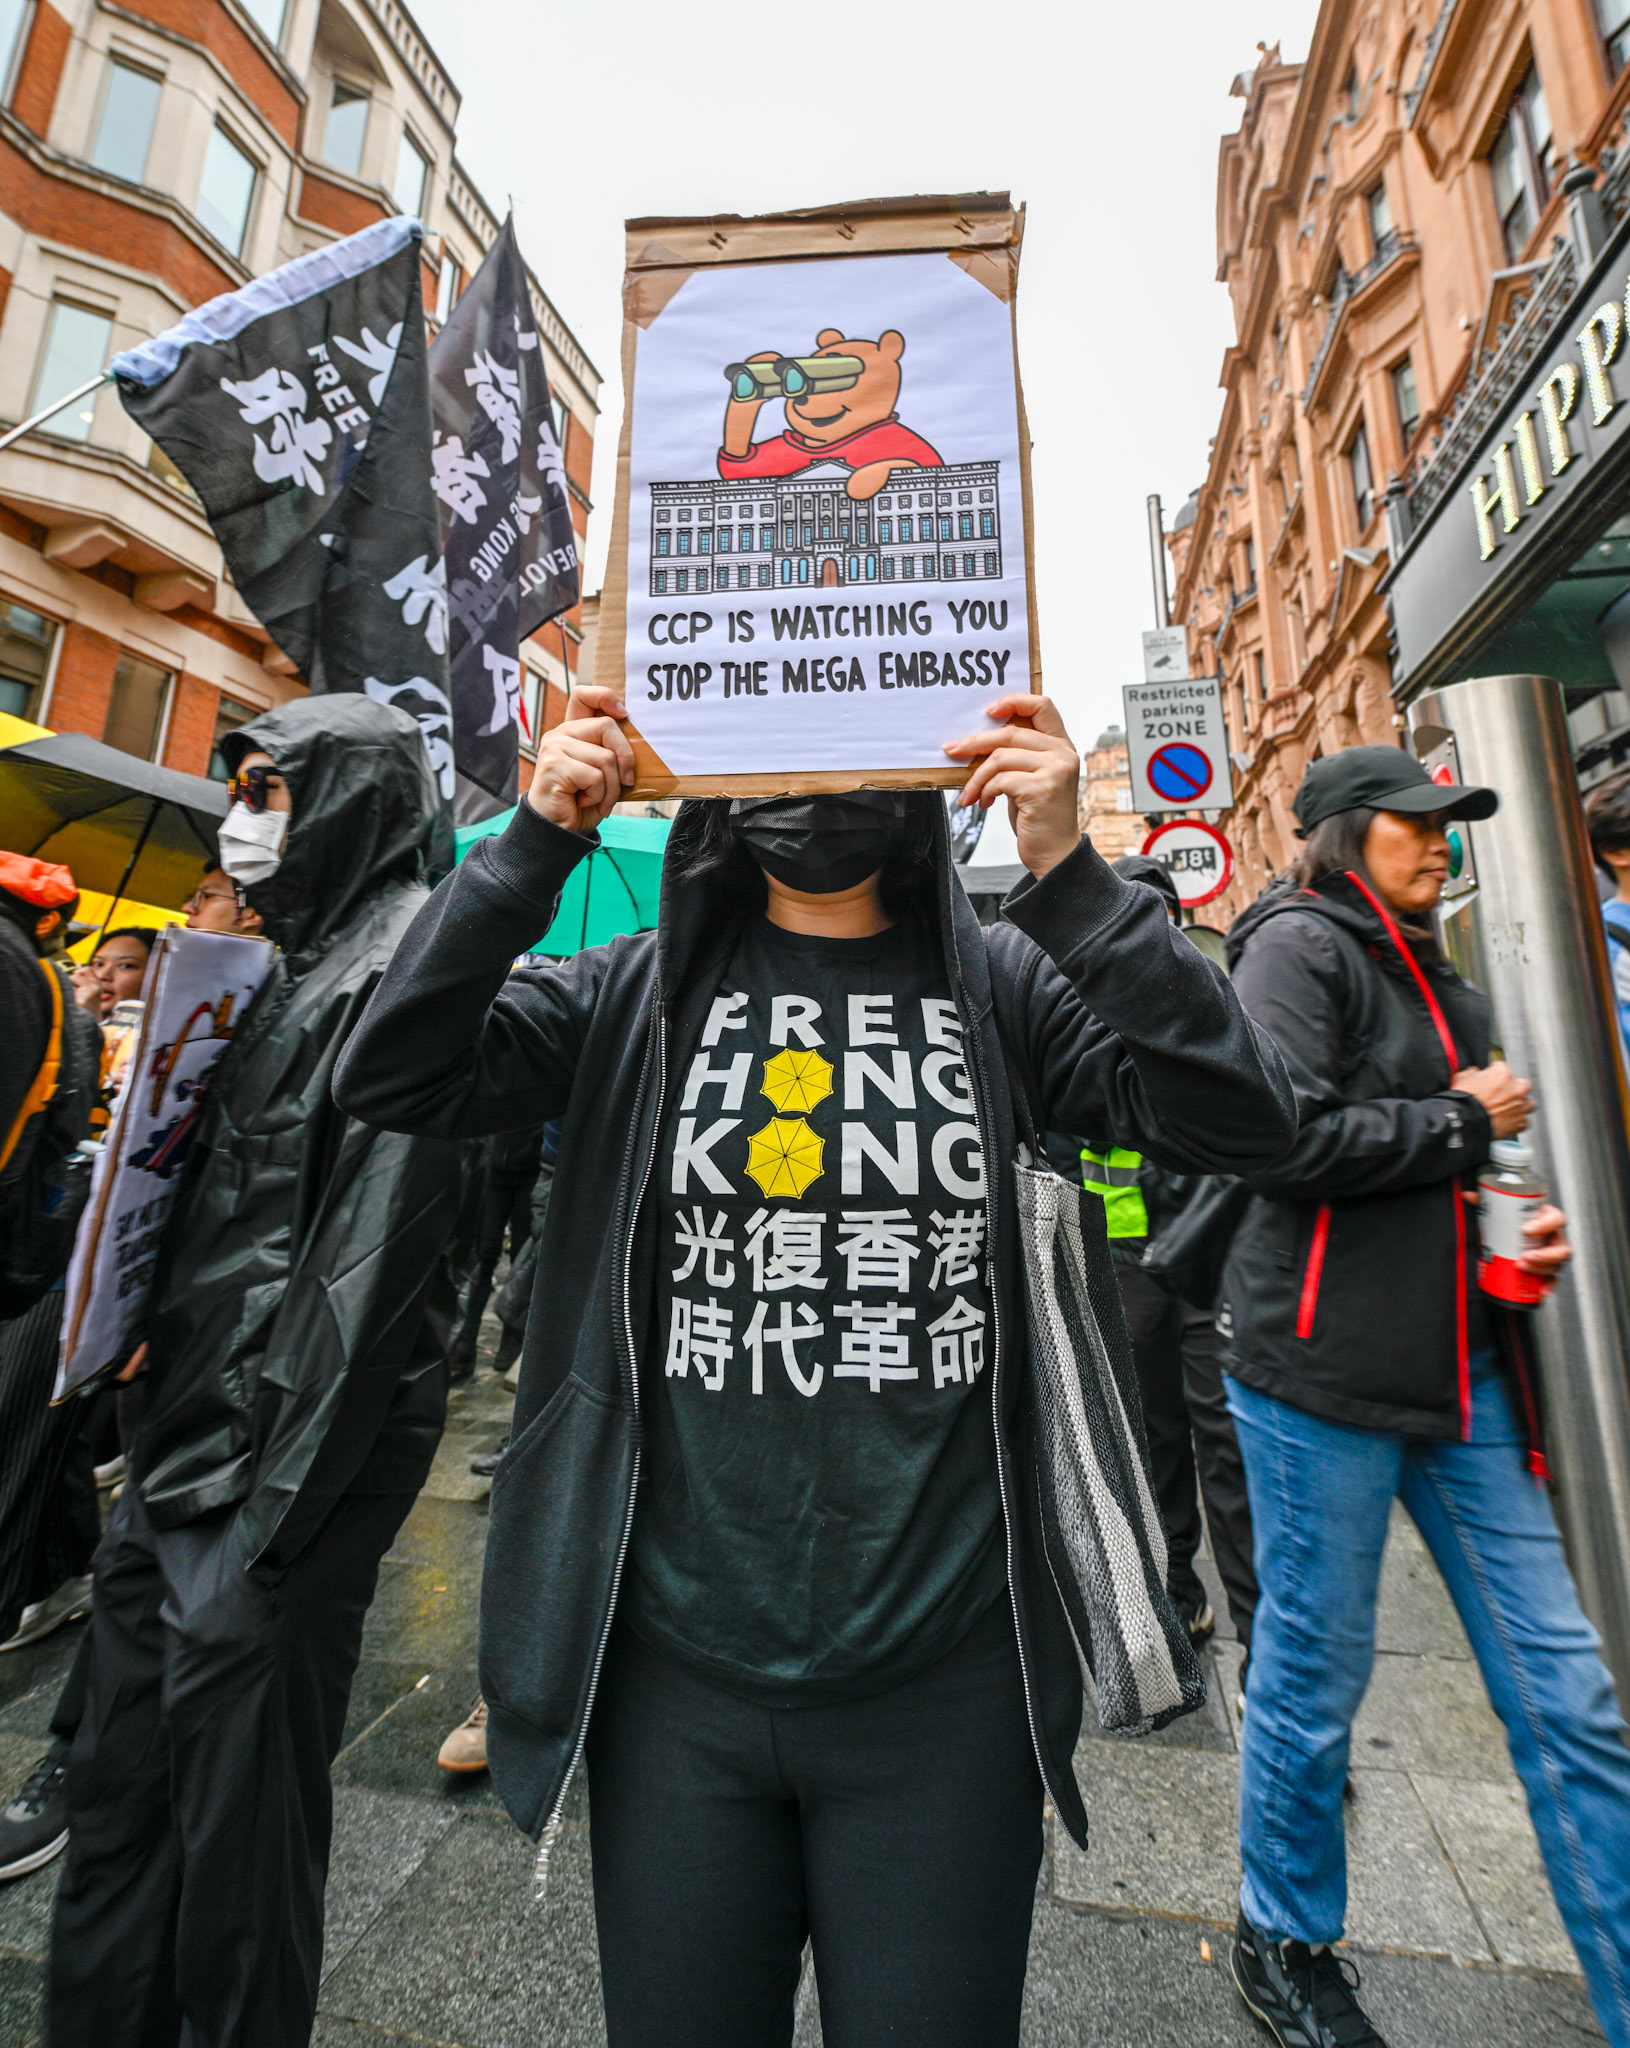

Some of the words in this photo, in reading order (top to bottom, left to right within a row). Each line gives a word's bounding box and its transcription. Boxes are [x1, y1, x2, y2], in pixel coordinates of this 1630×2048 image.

[306, 343, 372, 434] FREE
[1470, 273, 1630, 562] HIPP
[649, 611, 713, 646] CCP
[728, 610, 755, 643] IS
[771, 600, 932, 641] WATCHING
[948, 599, 1009, 634] YOU
[647, 662, 712, 701] STOP
[720, 661, 768, 698] THE
[782, 655, 866, 693] MEGA
[879, 649, 1011, 690] EMBASSY
[1128, 684, 1216, 702] Restricted
[1142, 703, 1205, 719] parking
[1144, 720, 1207, 739] ZONE
[701, 992, 963, 1053] FREE
[680, 1049, 974, 1114] HNG
[671, 1117, 986, 1200] KNG
[671, 1206, 987, 1293] 光復香港
[665, 1295, 986, 1398] 時代革命
